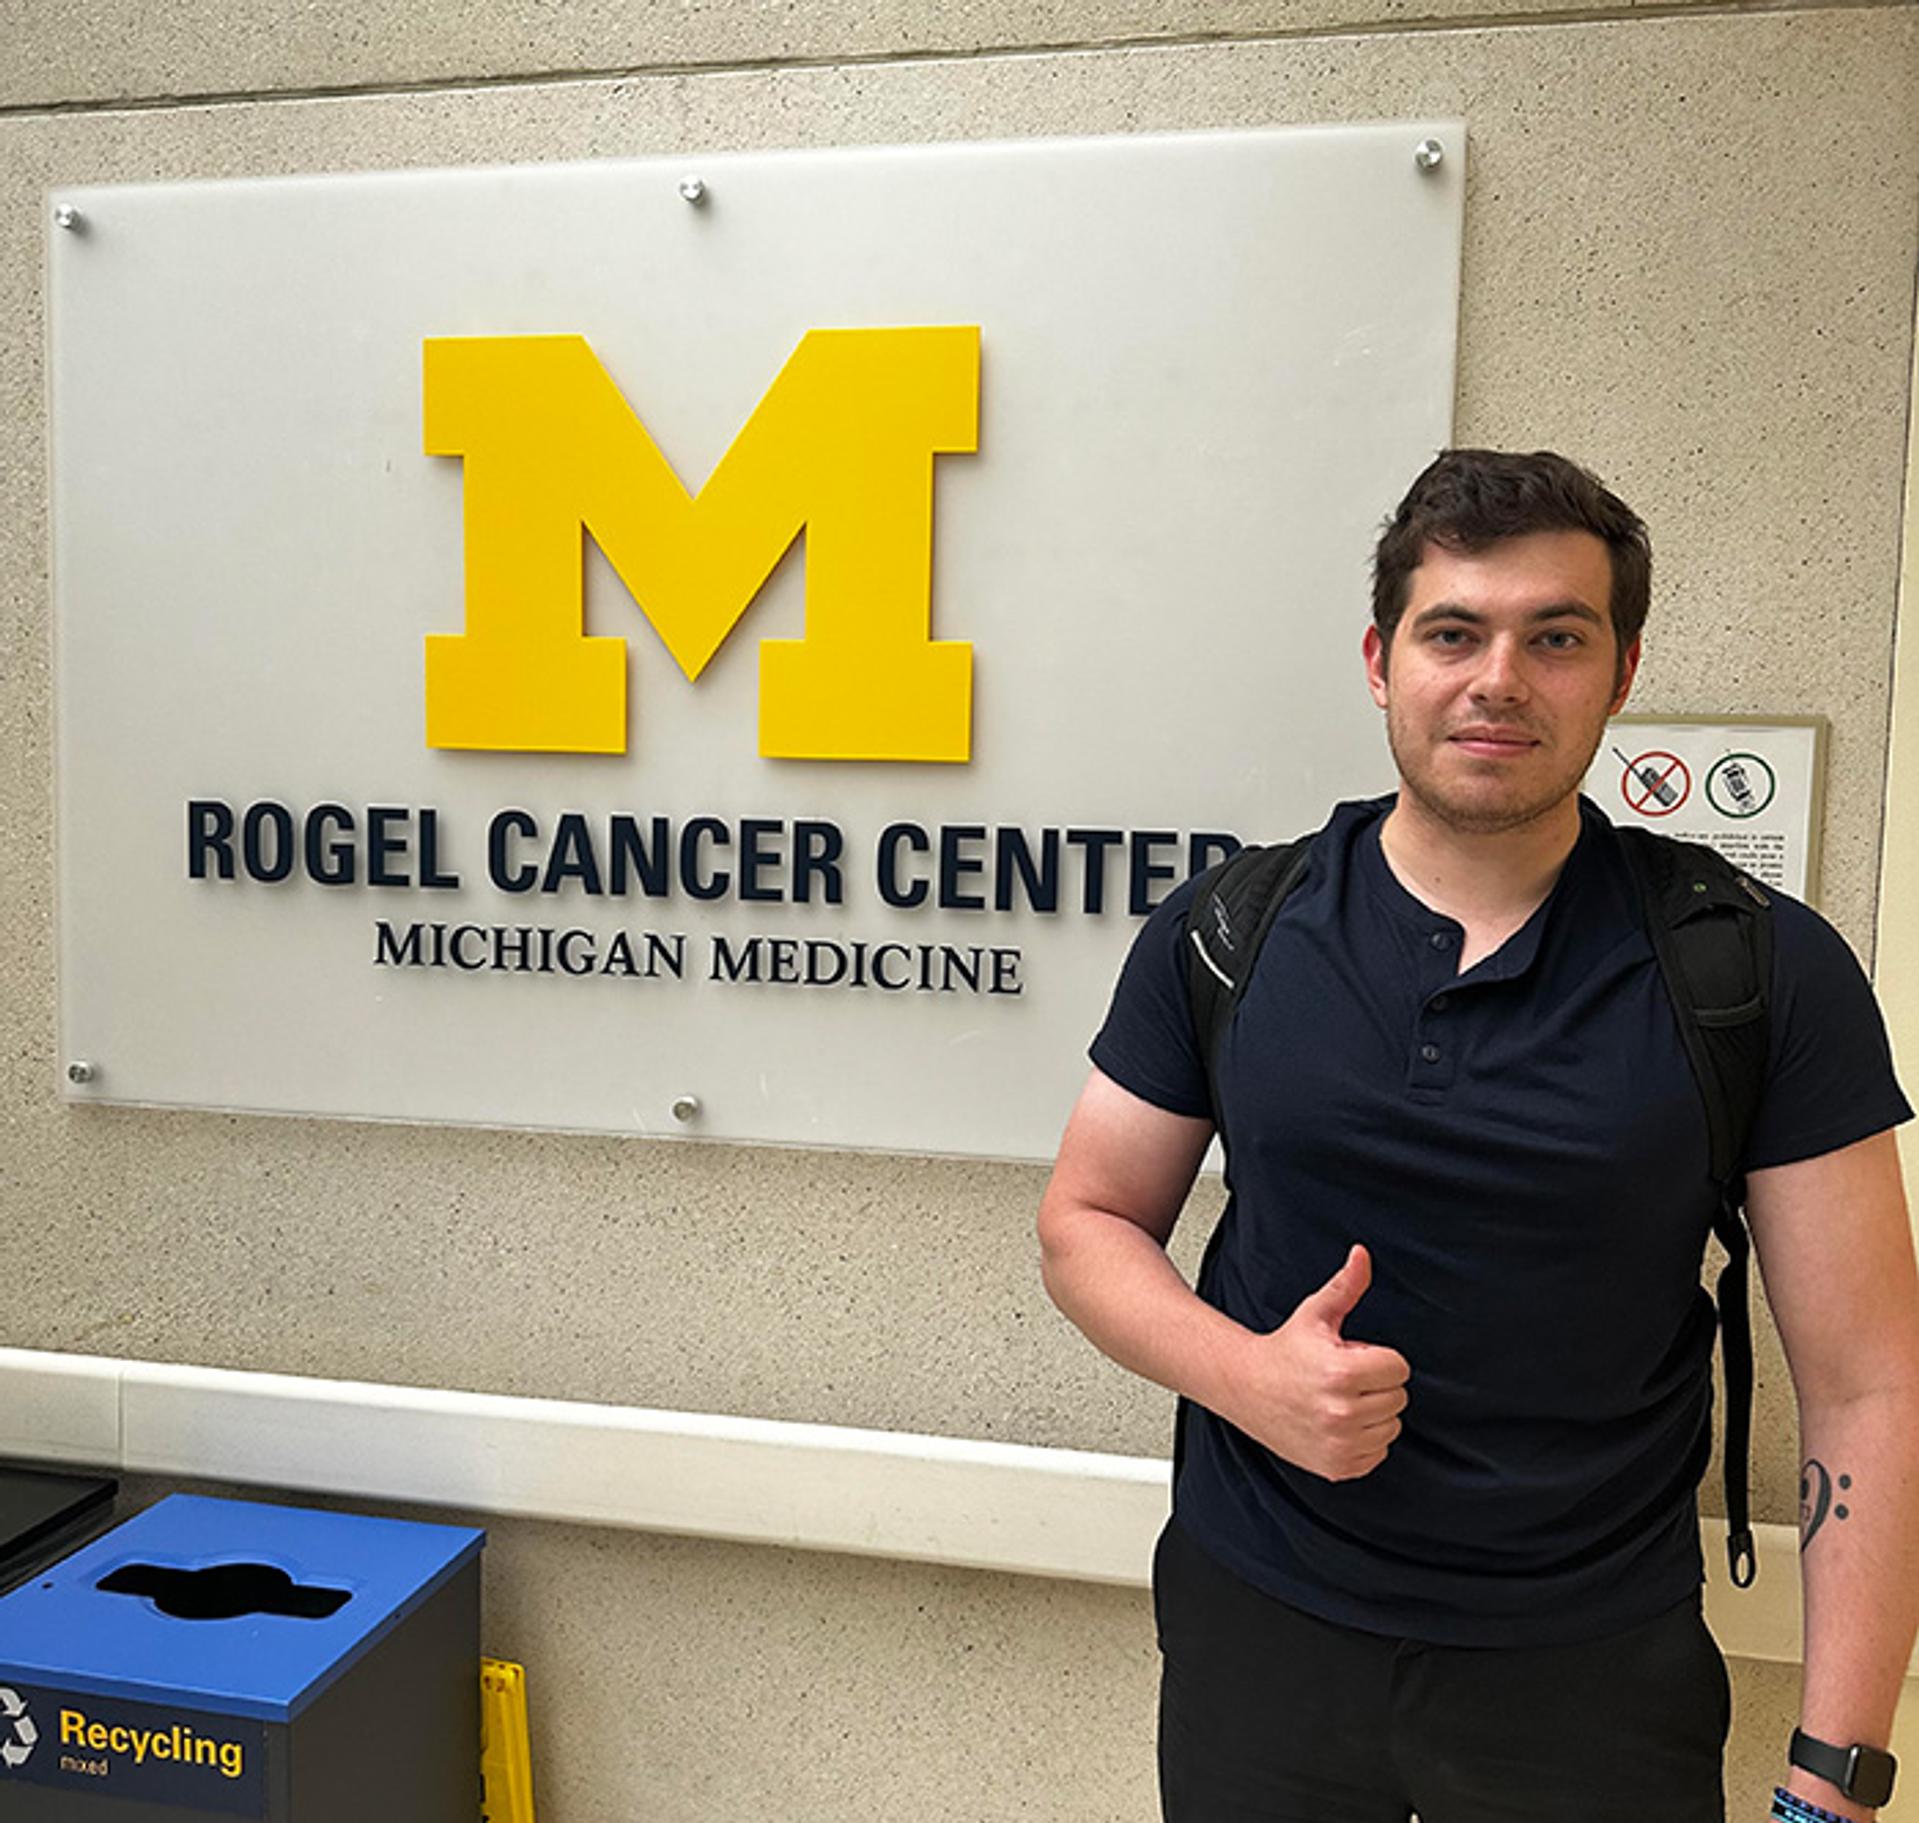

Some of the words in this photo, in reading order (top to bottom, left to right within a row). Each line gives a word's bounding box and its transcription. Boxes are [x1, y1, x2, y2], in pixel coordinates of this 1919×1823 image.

[422, 325, 982, 763] M
[187, 800, 460, 889] ROGEL
[487, 809, 843, 905] CANCER
[373, 921, 686, 979] MICHIGAN
[709, 936, 1024, 995] MEDICINE
[59, 1708, 244, 1779] Recycling
